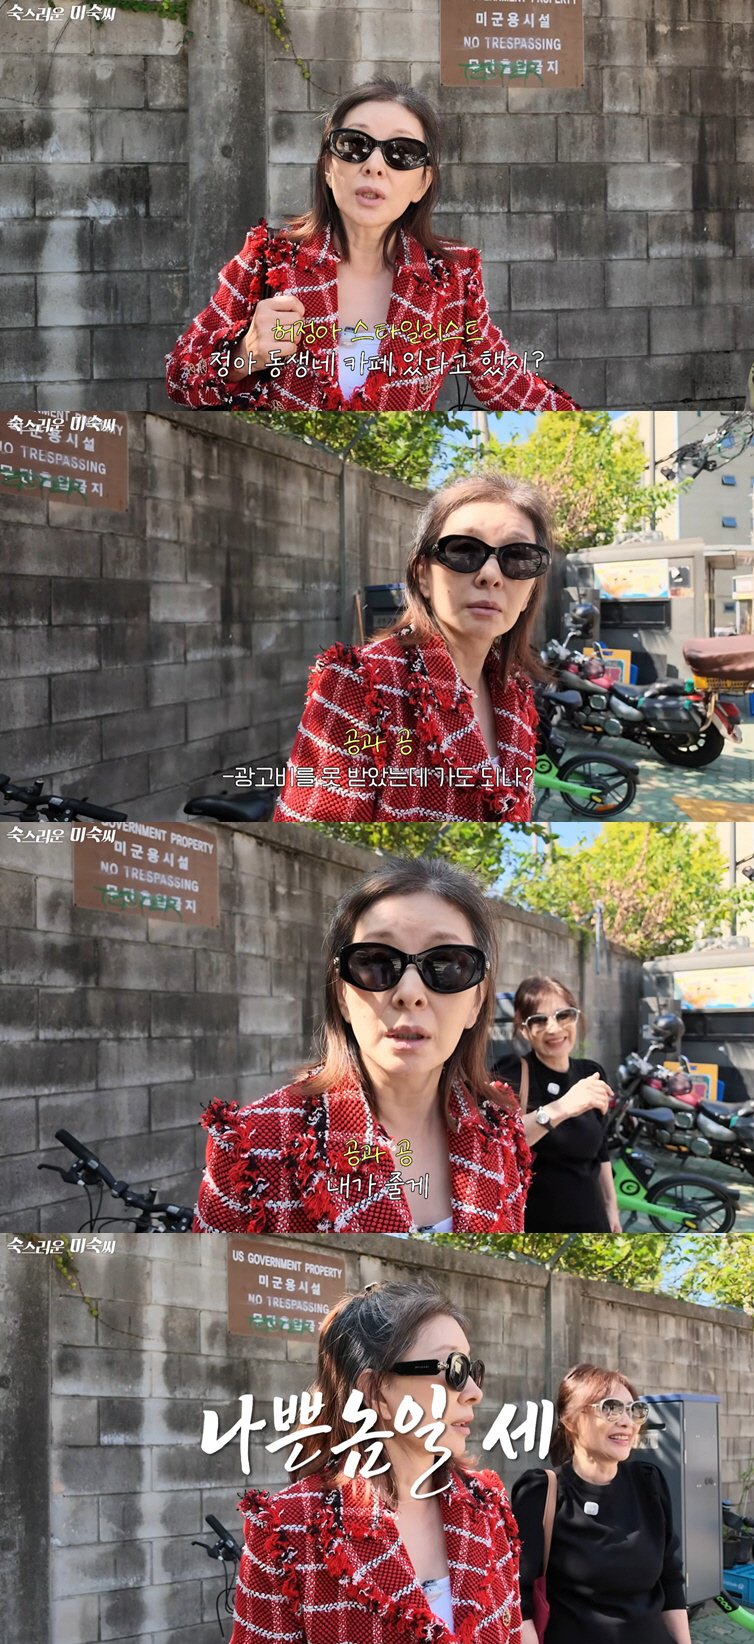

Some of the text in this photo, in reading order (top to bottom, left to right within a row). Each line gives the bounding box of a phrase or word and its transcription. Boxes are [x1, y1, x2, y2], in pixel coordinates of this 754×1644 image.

[475, 12, 551, 29] 미군용시설
[464, 36, 562, 50] NO TRESPASSING
[20, 445, 107, 475] TRESPASSING
[170, 833, 214, 854] PROPERTY
[114, 841, 189, 871] 미군용시설
[101, 861, 199, 893] NO TRESPASSING
[232, 1249, 342, 1279] US GOVERNMENT PROPERTY
[258, 1274, 321, 1296] 미군용시설
[248, 1292, 330, 1314] NO TRESPASSING
